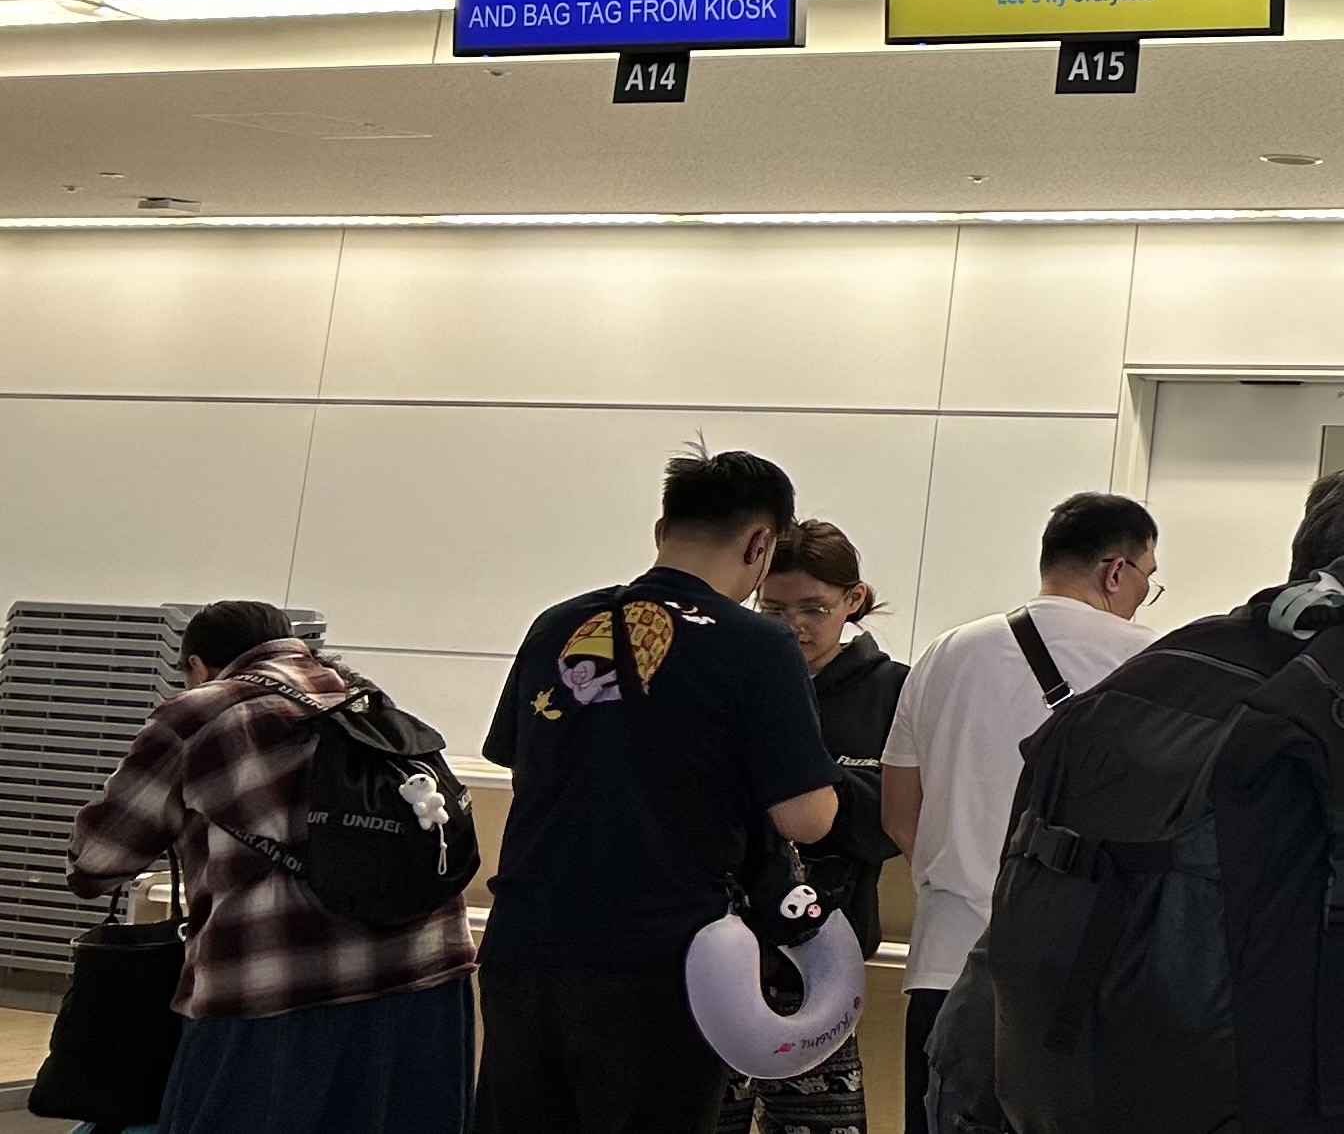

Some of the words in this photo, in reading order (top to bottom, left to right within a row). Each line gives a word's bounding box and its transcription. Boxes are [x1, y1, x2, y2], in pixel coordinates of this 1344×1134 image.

[468, 4, 516, 28] AND
[523, 2, 571, 27] BAG
[577, 0, 622, 25] TAG
[624, 62, 676, 91] A14
[1068, 51, 1126, 82] A15
